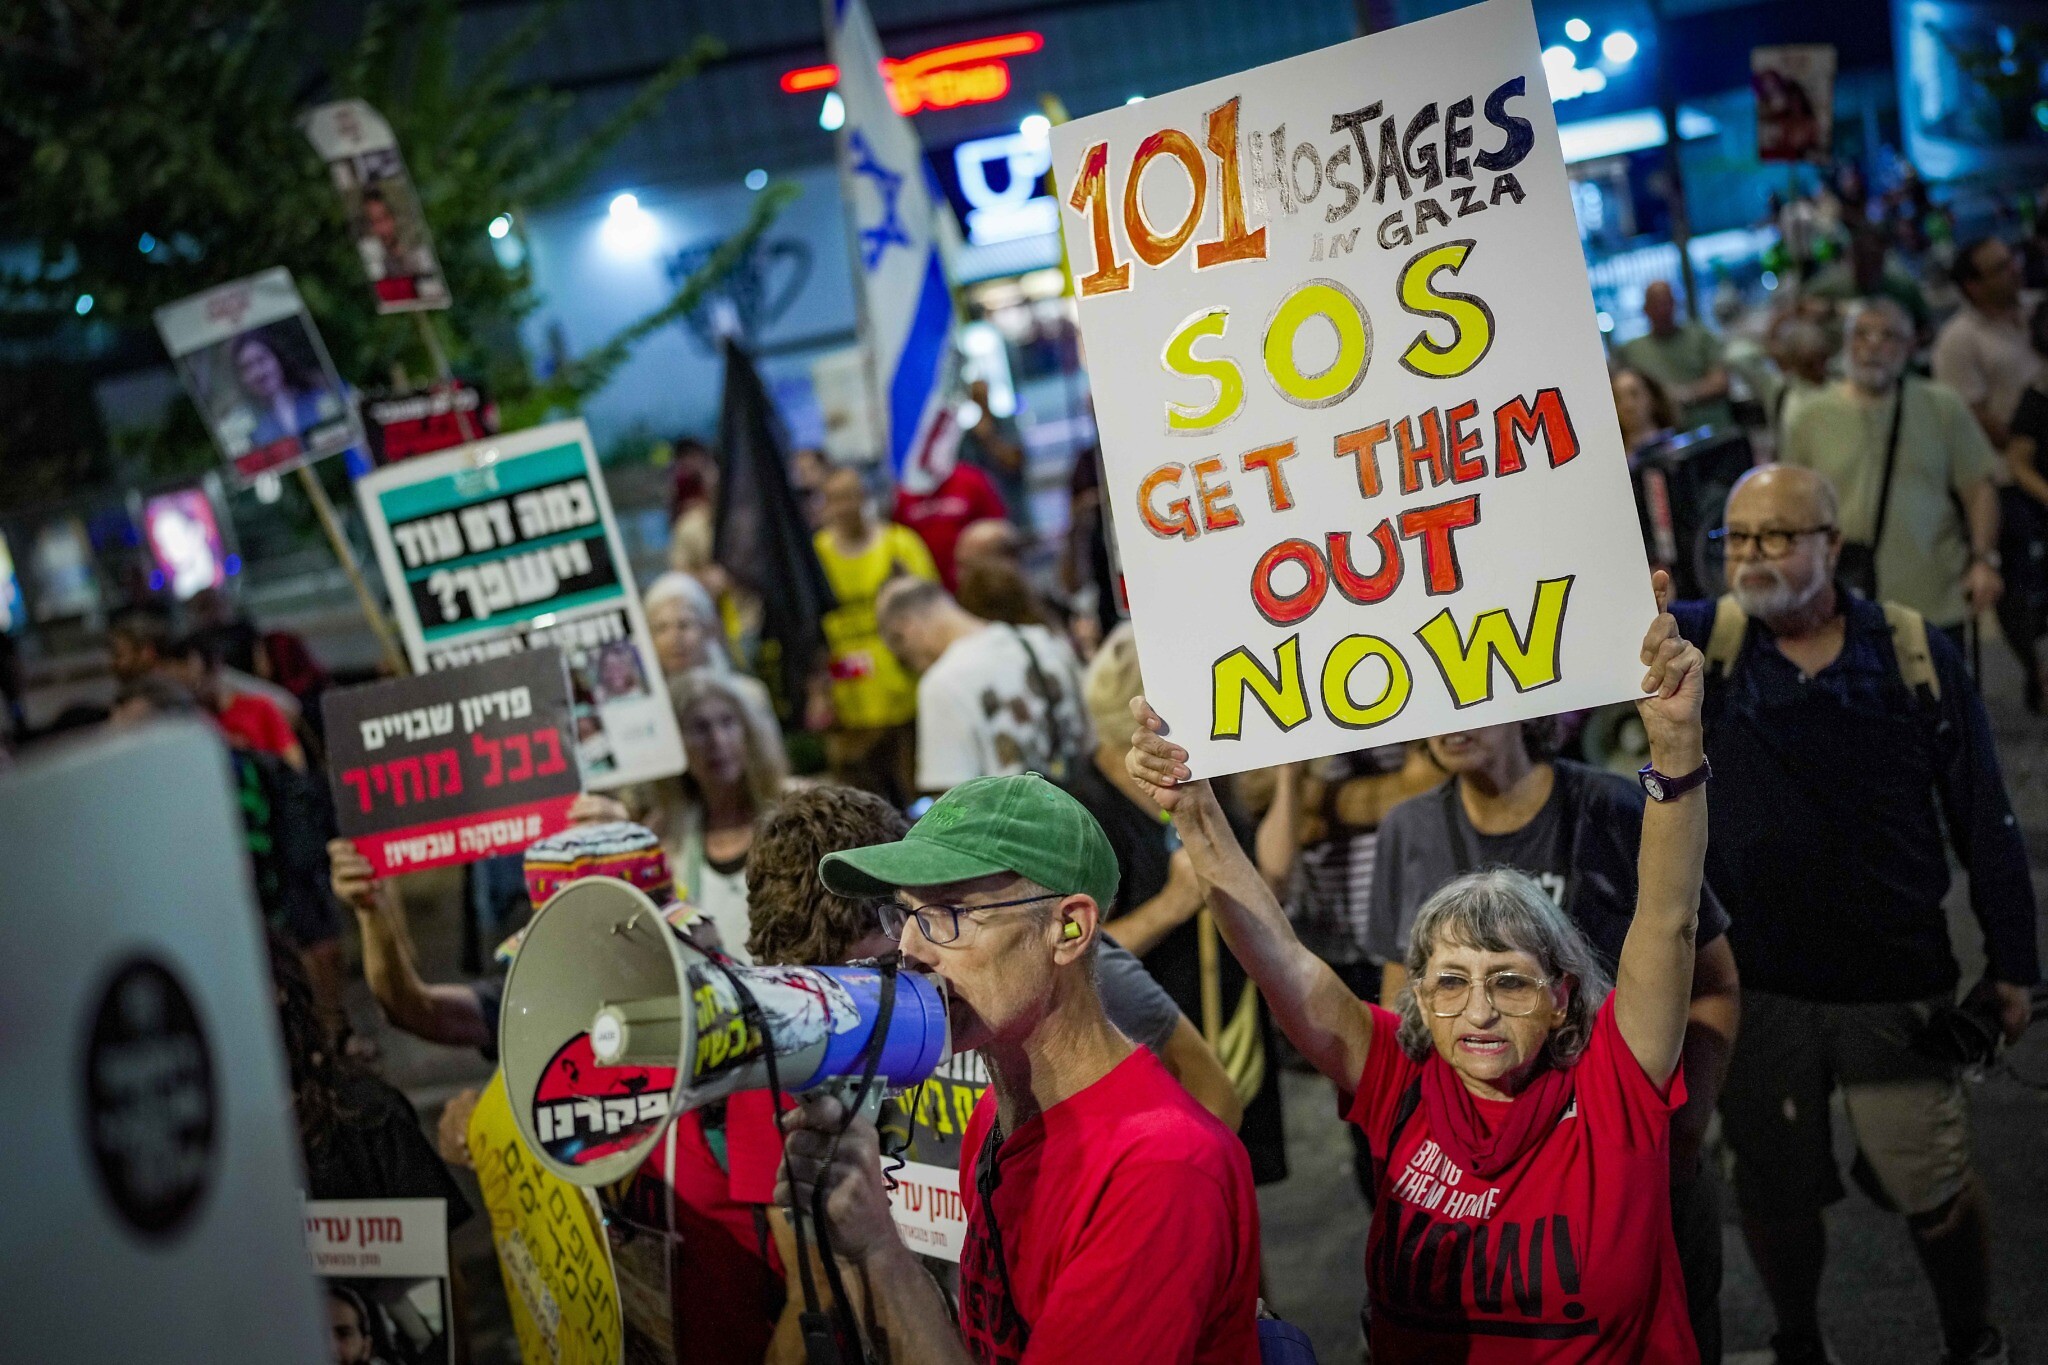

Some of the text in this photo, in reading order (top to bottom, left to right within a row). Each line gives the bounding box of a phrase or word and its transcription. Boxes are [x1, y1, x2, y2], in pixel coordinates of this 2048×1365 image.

[1066, 95, 1270, 300] 101
[1248, 76, 1535, 222] HOSTAGES
[1377, 173, 1527, 250] GAZA
[1160, 238, 1496, 437] SOS
[1136, 387, 1580, 542] GET THEM
[460, 498, 516, 554] דם
[512, 478, 598, 539] כמה
[393, 515, 465, 570] עוד
[1251, 494, 1481, 628] OUT
[1210, 574, 1575, 742] NOW
[359, 685, 533, 751] פדיון שבויים
[341, 748, 464, 814] מחיר
[472, 726, 567, 788] בכל
[1392, 1164, 1443, 1210] THEM
[357, 1217, 404, 1247] מתן
